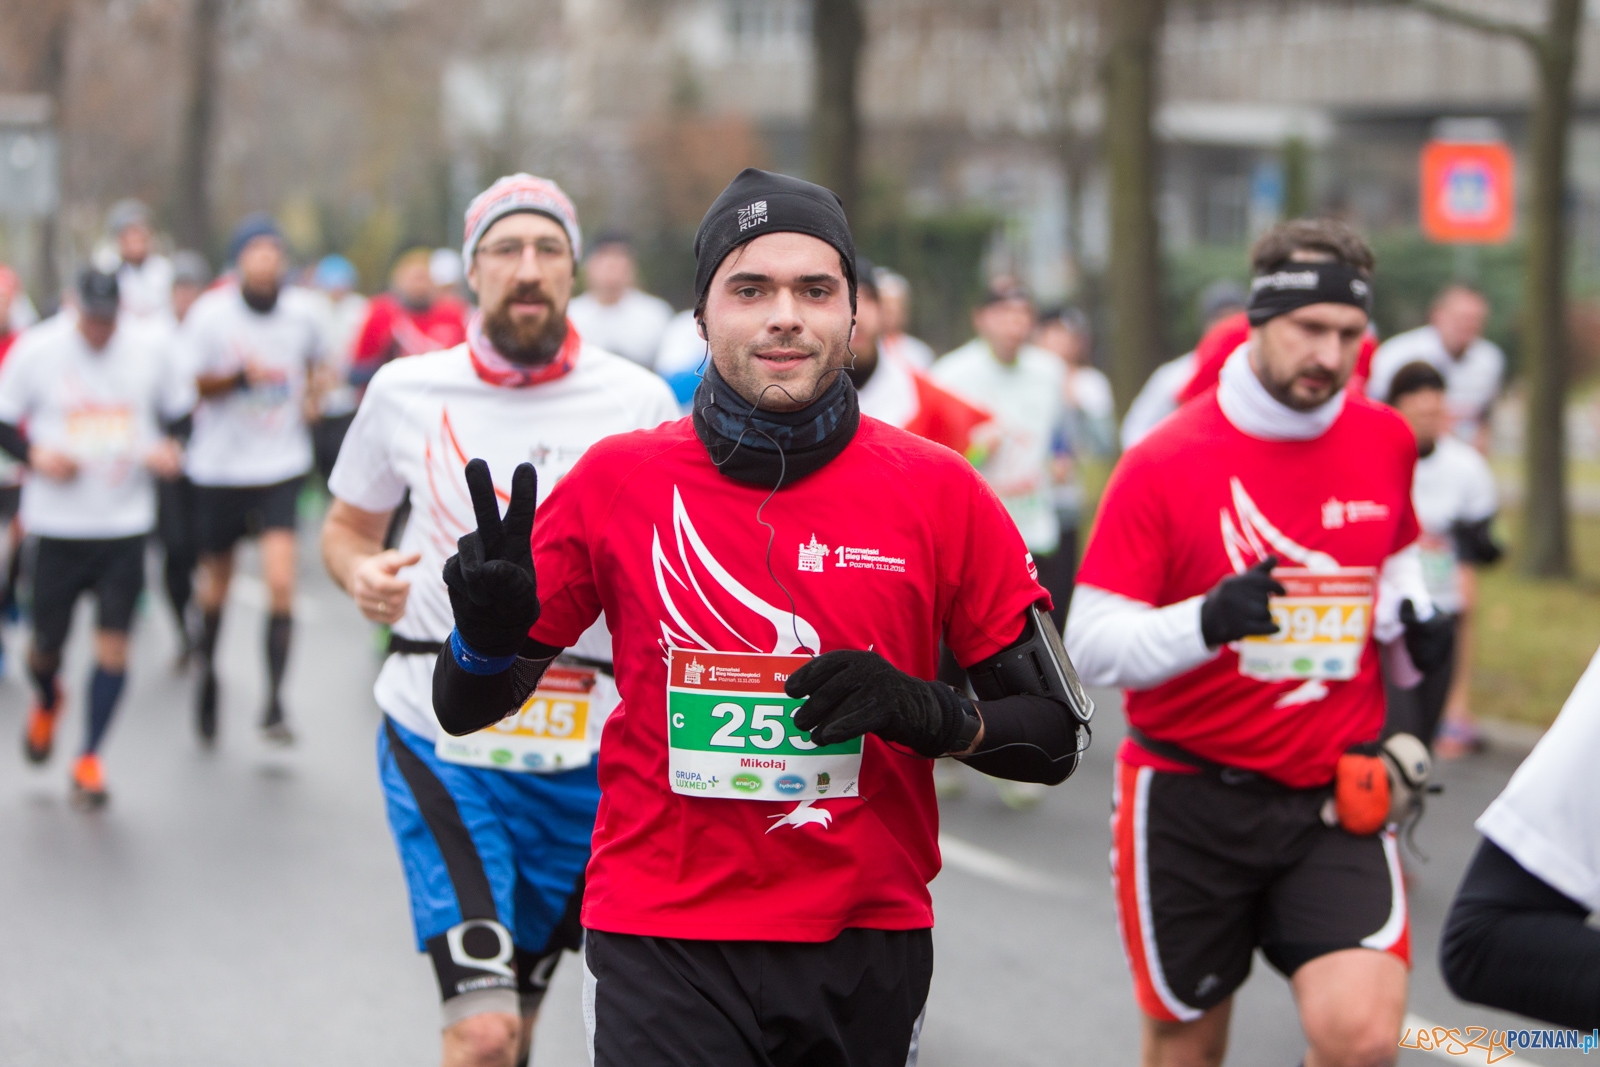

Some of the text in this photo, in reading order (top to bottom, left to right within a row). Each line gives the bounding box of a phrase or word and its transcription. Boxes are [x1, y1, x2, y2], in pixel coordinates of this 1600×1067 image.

[740, 215, 768, 232] RUN
[834, 546, 847, 567] 1
[845, 553, 861, 561] Bieg
[708, 665, 718, 682] 1
[672, 712, 685, 729] C
[740, 758, 786, 771] Mikołaj
[675, 770, 702, 781] GRUPA
[676, 779, 707, 790] LUXMED
